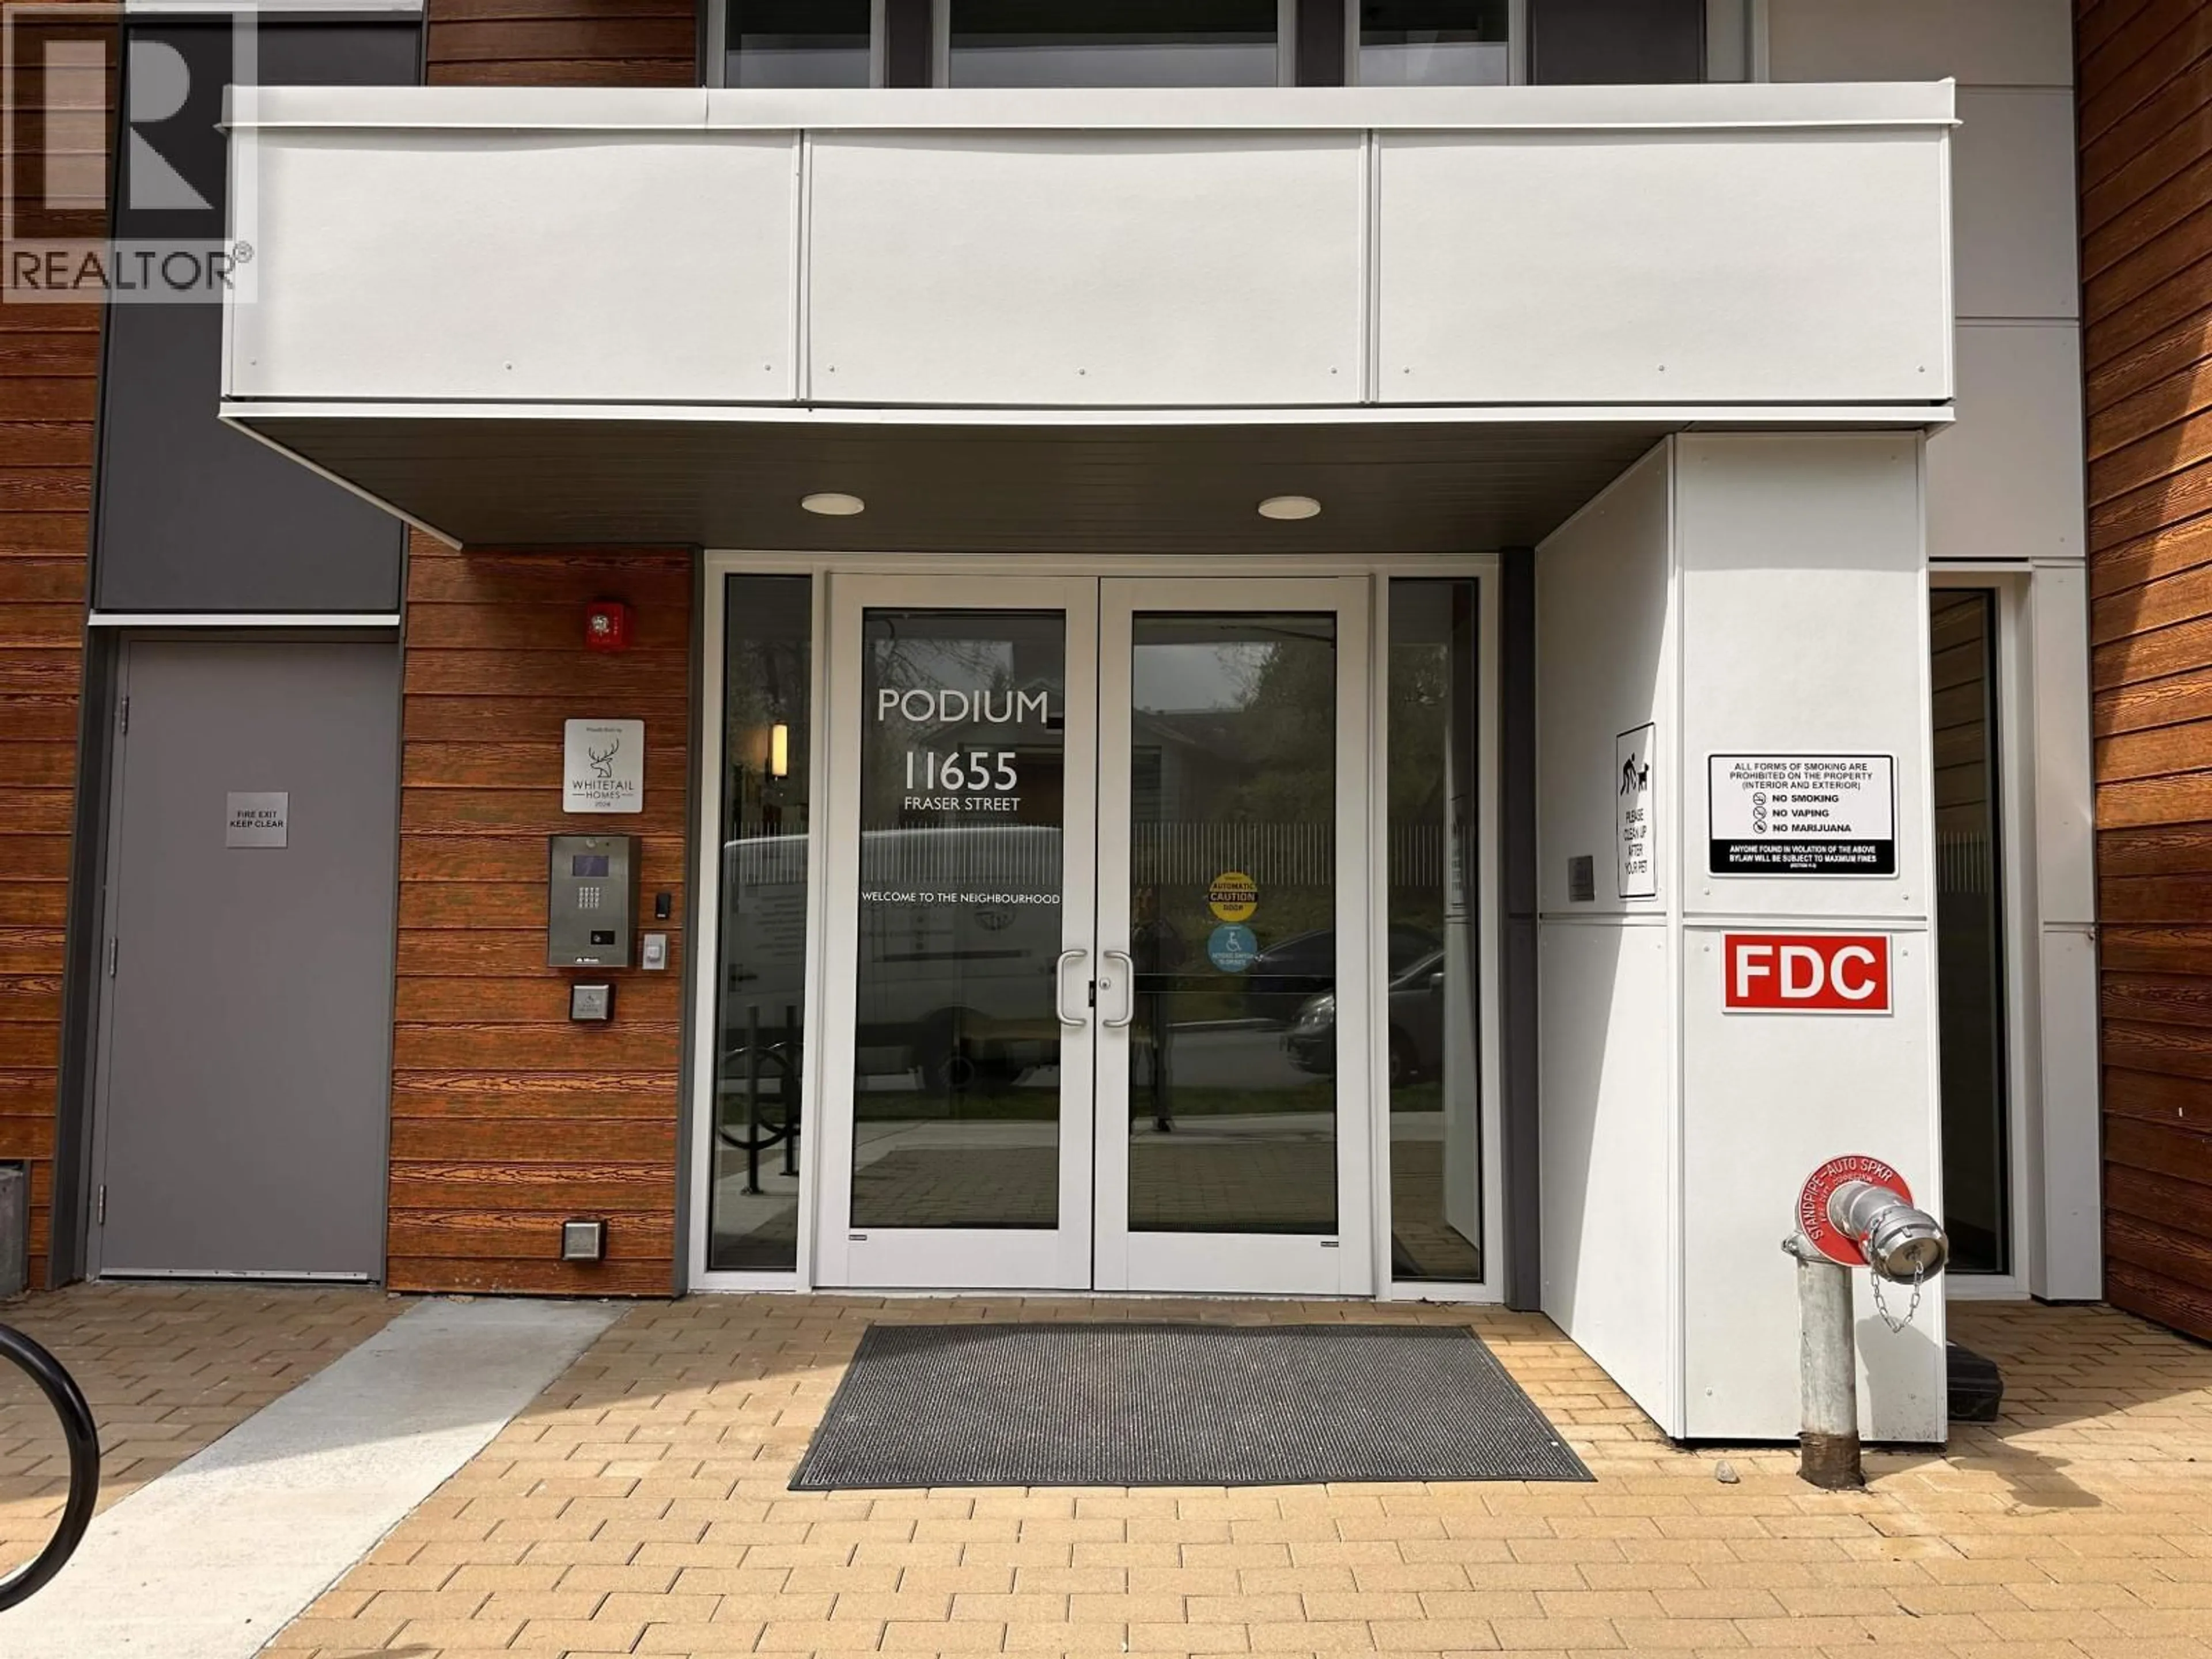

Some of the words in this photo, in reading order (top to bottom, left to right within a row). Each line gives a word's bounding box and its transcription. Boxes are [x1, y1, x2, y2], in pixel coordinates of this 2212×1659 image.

[878, 689, 1048, 724] PODIUM
[907, 751, 1017, 790] 11655
[1734, 763, 1752, 771] ALL
[1754, 763, 1787, 771] FORMS
[1789, 763, 1802, 771] OF
[1804, 763, 1847, 771] SMOKING
[1849, 763, 1868, 771] ARE
[1729, 771, 1786, 780] PROHIBITED
[1787, 771, 1801, 779] ON
[1823, 772, 1873, 781] PROPERTY
[573, 780, 634, 790] WHITETAIL
[1742, 781, 1789, 790] (INTERIOR
[1790, 781, 1809, 789] AND
[1812, 781, 1861, 790] EXTERIOR)
[586, 791, 620, 799] HOMES
[1772, 794, 1787, 802] NO
[1791, 794, 1839, 802] SMOKING
[904, 797, 961, 810] FRASER
[964, 797, 1021, 811] STREET
[1772, 809, 1788, 817] NO
[1791, 809, 1830, 817] VAPING
[1772, 824, 1788, 832] NO
[1791, 824, 1852, 832] MARIJUANA
[1729, 844, 1758, 853] ANYONE
[1759, 844, 1782, 853] FOUND
[1783, 844, 1791, 853] IN
[1791, 844, 1827, 853] VIOLATION
[1828, 844, 1837, 853] OF
[1839, 844, 1851, 853] THE
[1853, 844, 1876, 854] ABOVE
[1729, 854, 1753, 862] BYLAW
[862, 892, 916, 902] WELCOME
[920, 893, 934, 903] TO
[937, 893, 957, 903] THE
[960, 893, 1060, 904] NEIGHBOURHOOD
[1210, 893, 1255, 901] CAUTION
[1736, 945, 1877, 1000] FDC
[1861, 1158, 1893, 1181] SPKR
